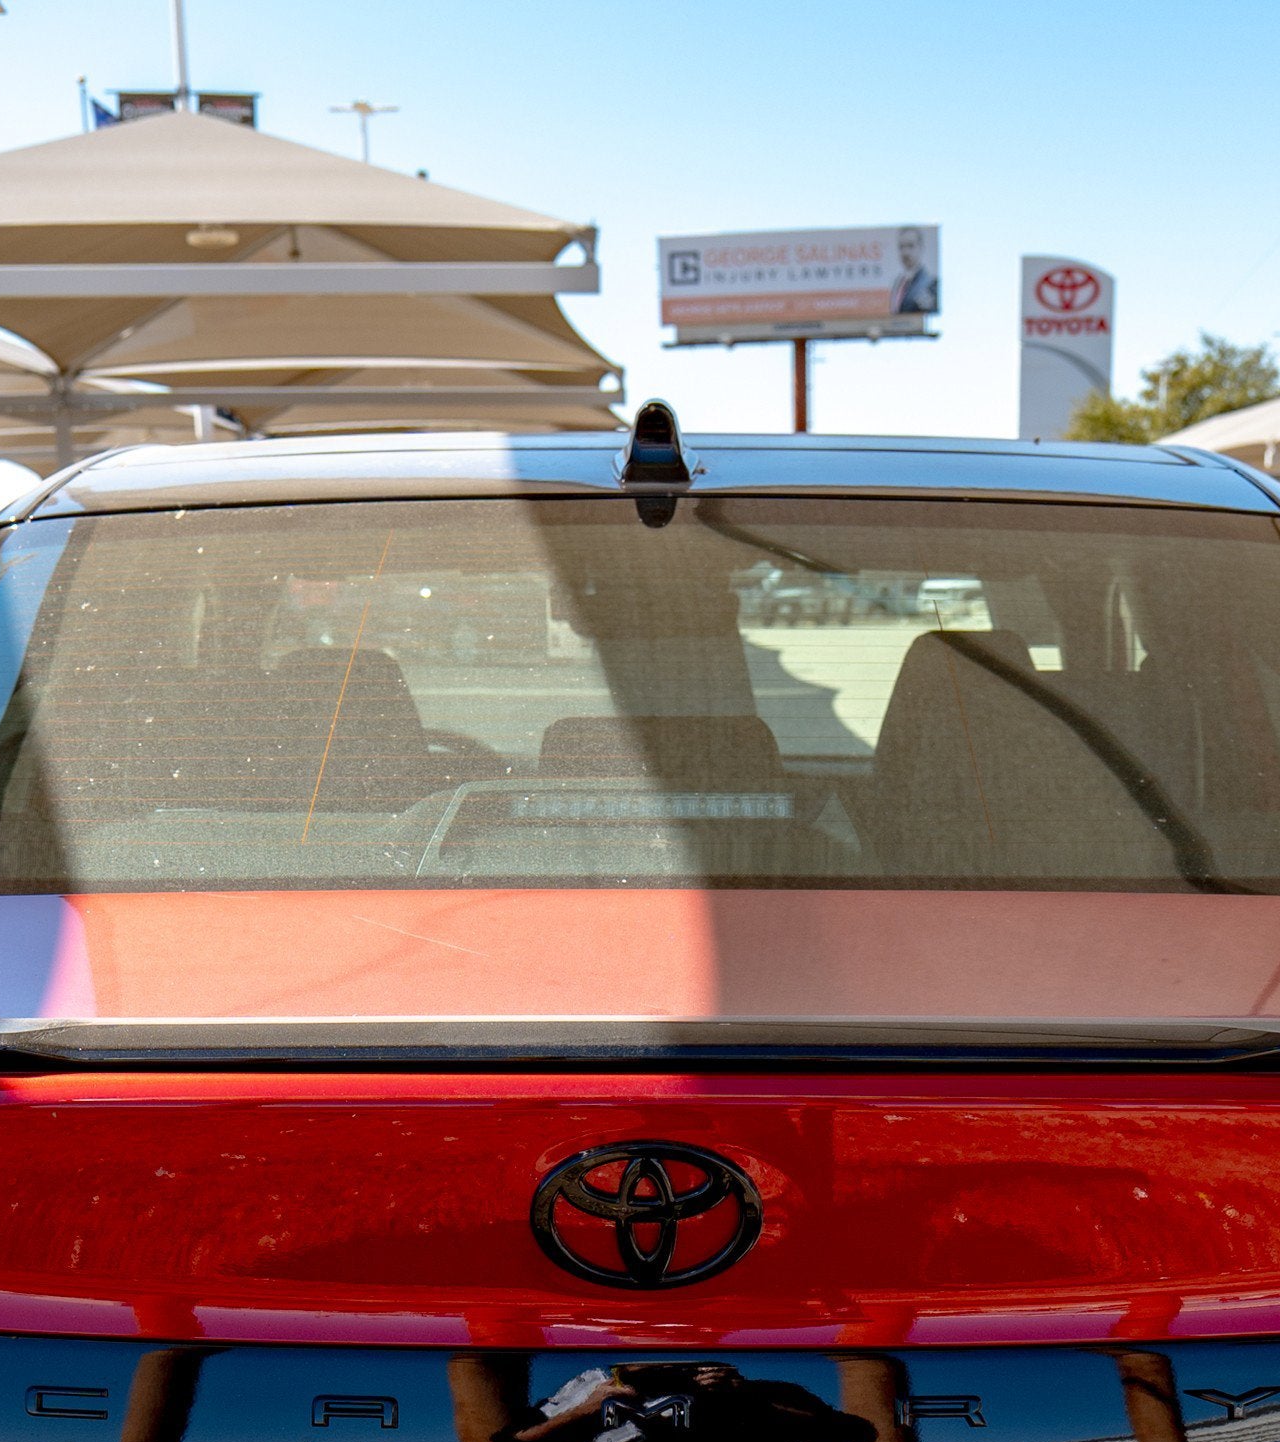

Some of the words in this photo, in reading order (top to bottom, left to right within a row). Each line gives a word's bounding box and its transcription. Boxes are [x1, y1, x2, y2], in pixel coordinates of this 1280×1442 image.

[704, 245, 790, 268] GEORGE
[794, 241, 883, 263] SALINAS
[705, 267, 779, 285] INJURY
[787, 263, 883, 281] LAWYERS
[1025, 317, 1110, 336] TOYOTA
